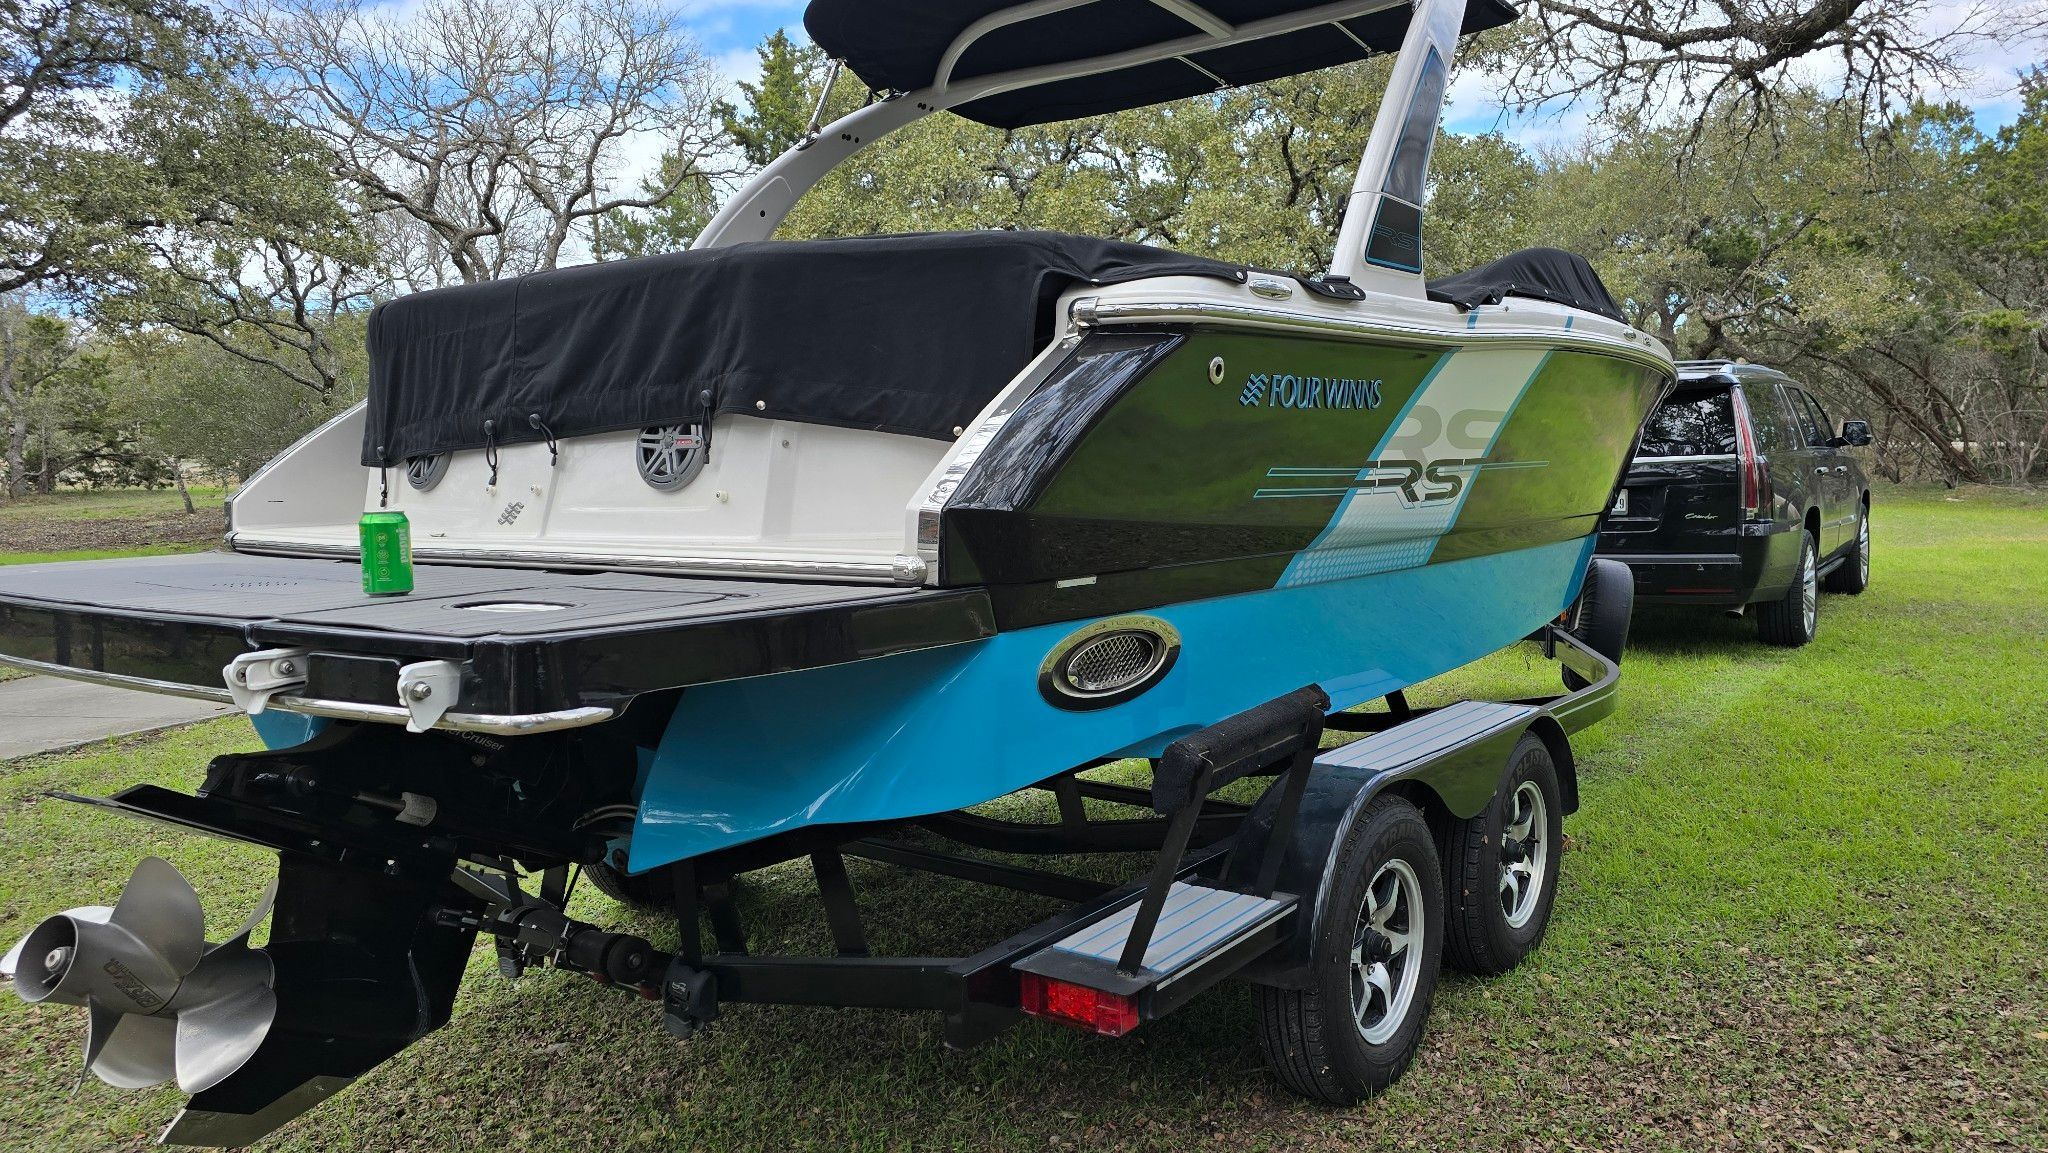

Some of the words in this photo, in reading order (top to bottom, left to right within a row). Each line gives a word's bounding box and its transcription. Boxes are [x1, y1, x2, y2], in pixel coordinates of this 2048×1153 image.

[1269, 374, 1321, 409] FOUR
[1324, 377, 1383, 411] WINNS
[1351, 457, 1484, 506] RS
[446, 729, 505, 751] erCruiser
